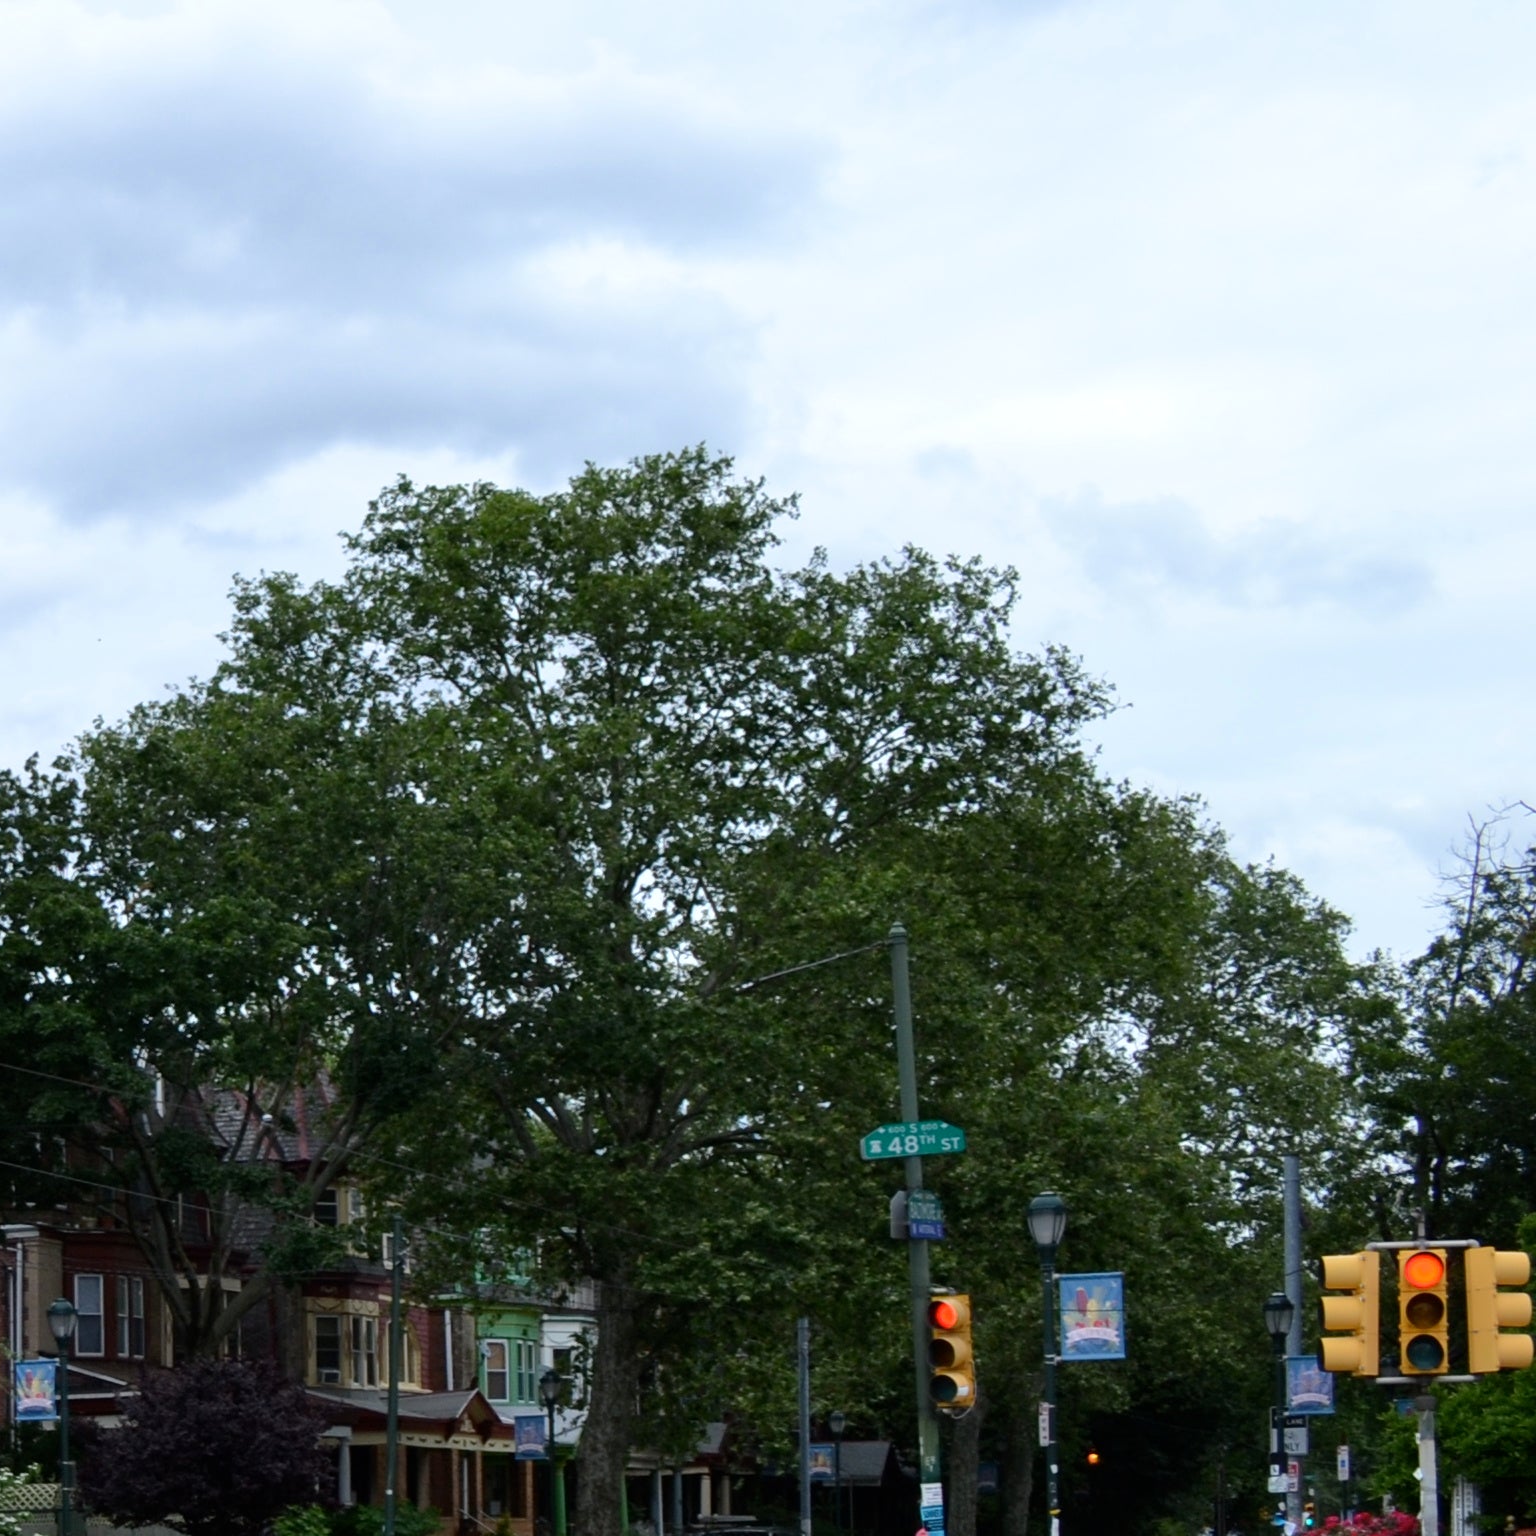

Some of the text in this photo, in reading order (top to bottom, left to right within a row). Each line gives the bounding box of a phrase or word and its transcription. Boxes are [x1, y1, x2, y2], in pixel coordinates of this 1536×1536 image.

[909, 1123, 918, 1133] S
[887, 1134, 960, 1154] 48TH ST
[1283, 1441, 1300, 1452] NLY
